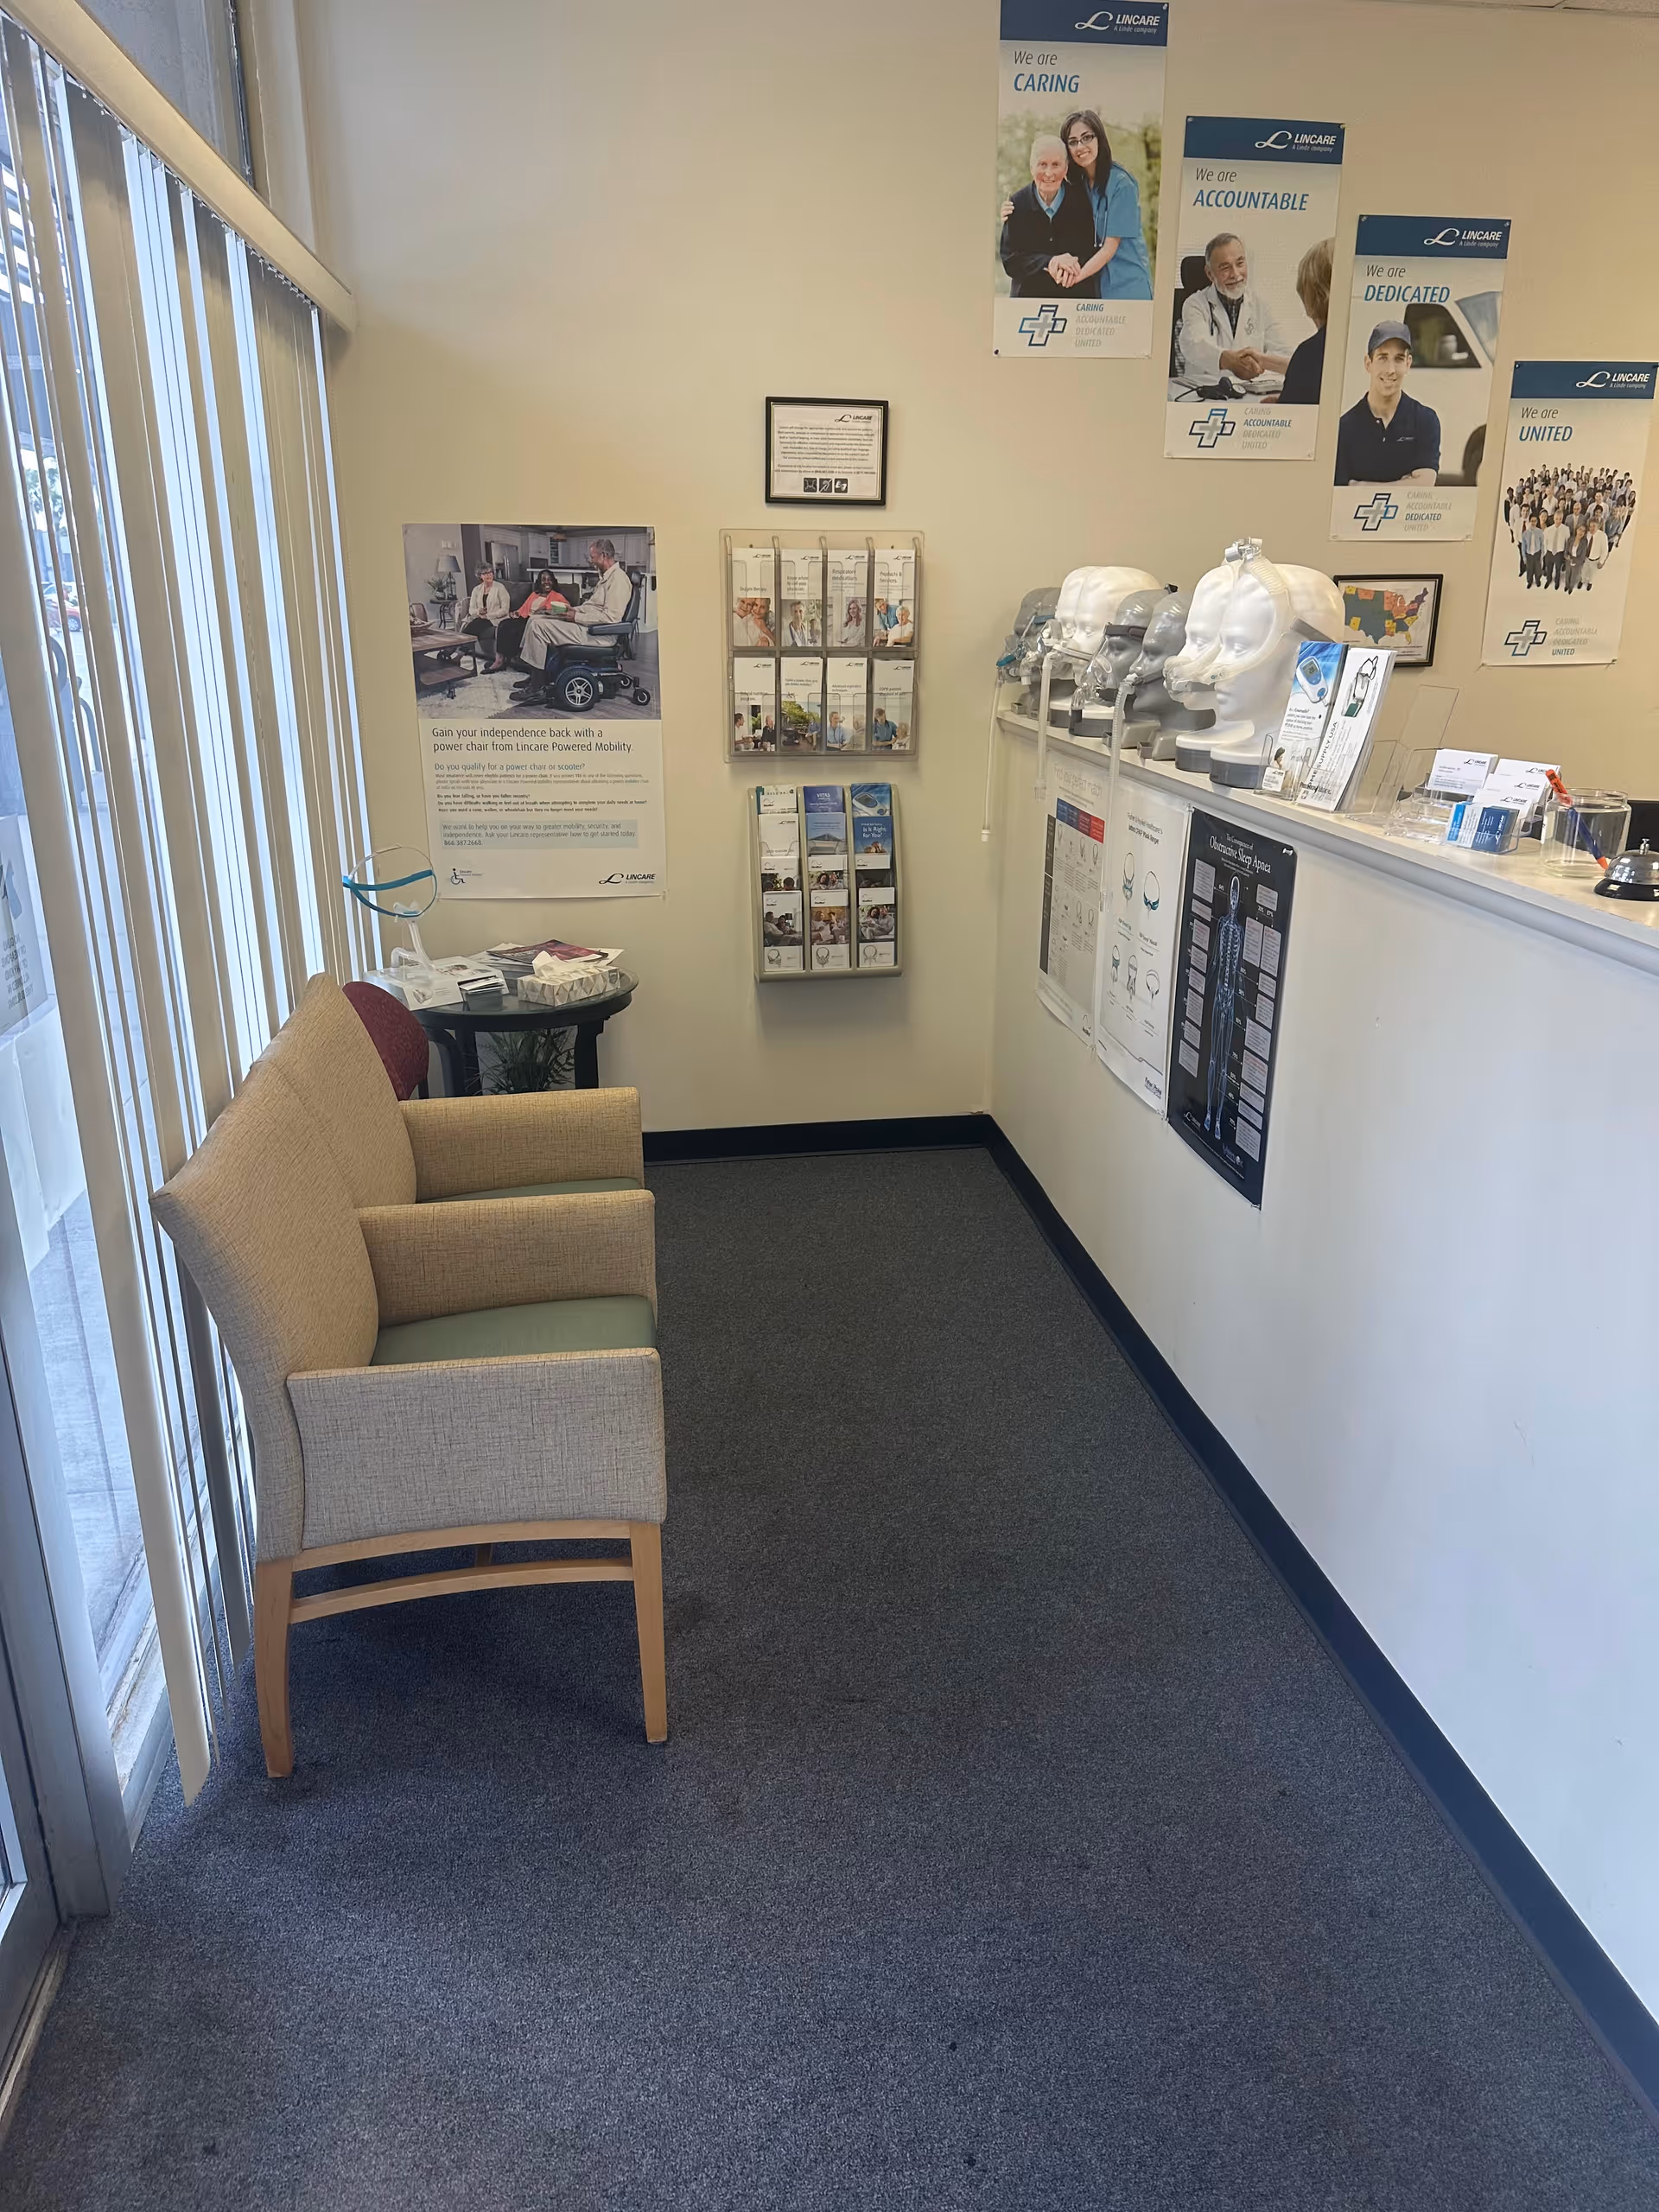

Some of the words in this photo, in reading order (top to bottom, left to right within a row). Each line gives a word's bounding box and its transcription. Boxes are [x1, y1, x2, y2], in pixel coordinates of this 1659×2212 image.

[1116, 14, 1160, 26] LINCARE
[1014, 50, 1033, 65] We
[1037, 54, 1058, 66] are
[1014, 73, 1080, 92] CARING
[1294, 133, 1337, 145] LINCARE
[1196, 168, 1213, 181] We
[1217, 171, 1236, 182] are
[1192, 189, 1309, 211] ACCOUNTABLE
[1462, 230, 1503, 241] LINCARE
[1366, 264, 1383, 277] We
[1388, 268, 1406, 277] are
[1363, 285, 1450, 302] DEDICATED
[1075, 315, 1127, 324] ACCOUNTABLE
[1612, 373, 1650, 382] LINCARE
[1521, 407, 1538, 418] We
[1541, 410, 1559, 418] are
[1243, 430, 1281, 439] DEDICATED
[1519, 426, 1573, 442] UNITED
[1407, 491, 1433, 499] CARING
[1404, 524, 1429, 532] UNITED
[432, 728, 453, 737] Gain
[456, 729, 477, 739] your
[480, 728, 546, 740] independence
[550, 728, 571, 737] back
[574, 728, 594, 737] with
[434, 743, 462, 753] power
[467, 741, 488, 751] chair
[493, 741, 512, 751] from
[517, 742, 548, 752] Lincare
[552, 742, 591, 752] Powered
[595, 741, 633, 753] Mobility.
[1317, 740, 1331, 769] SUPPLY
[461, 762, 485, 772] qualify
[1210, 836, 1237, 858] Obstructive
[1238, 849, 1252, 868] Sleep
[1253, 855, 1271, 873] Apnea
